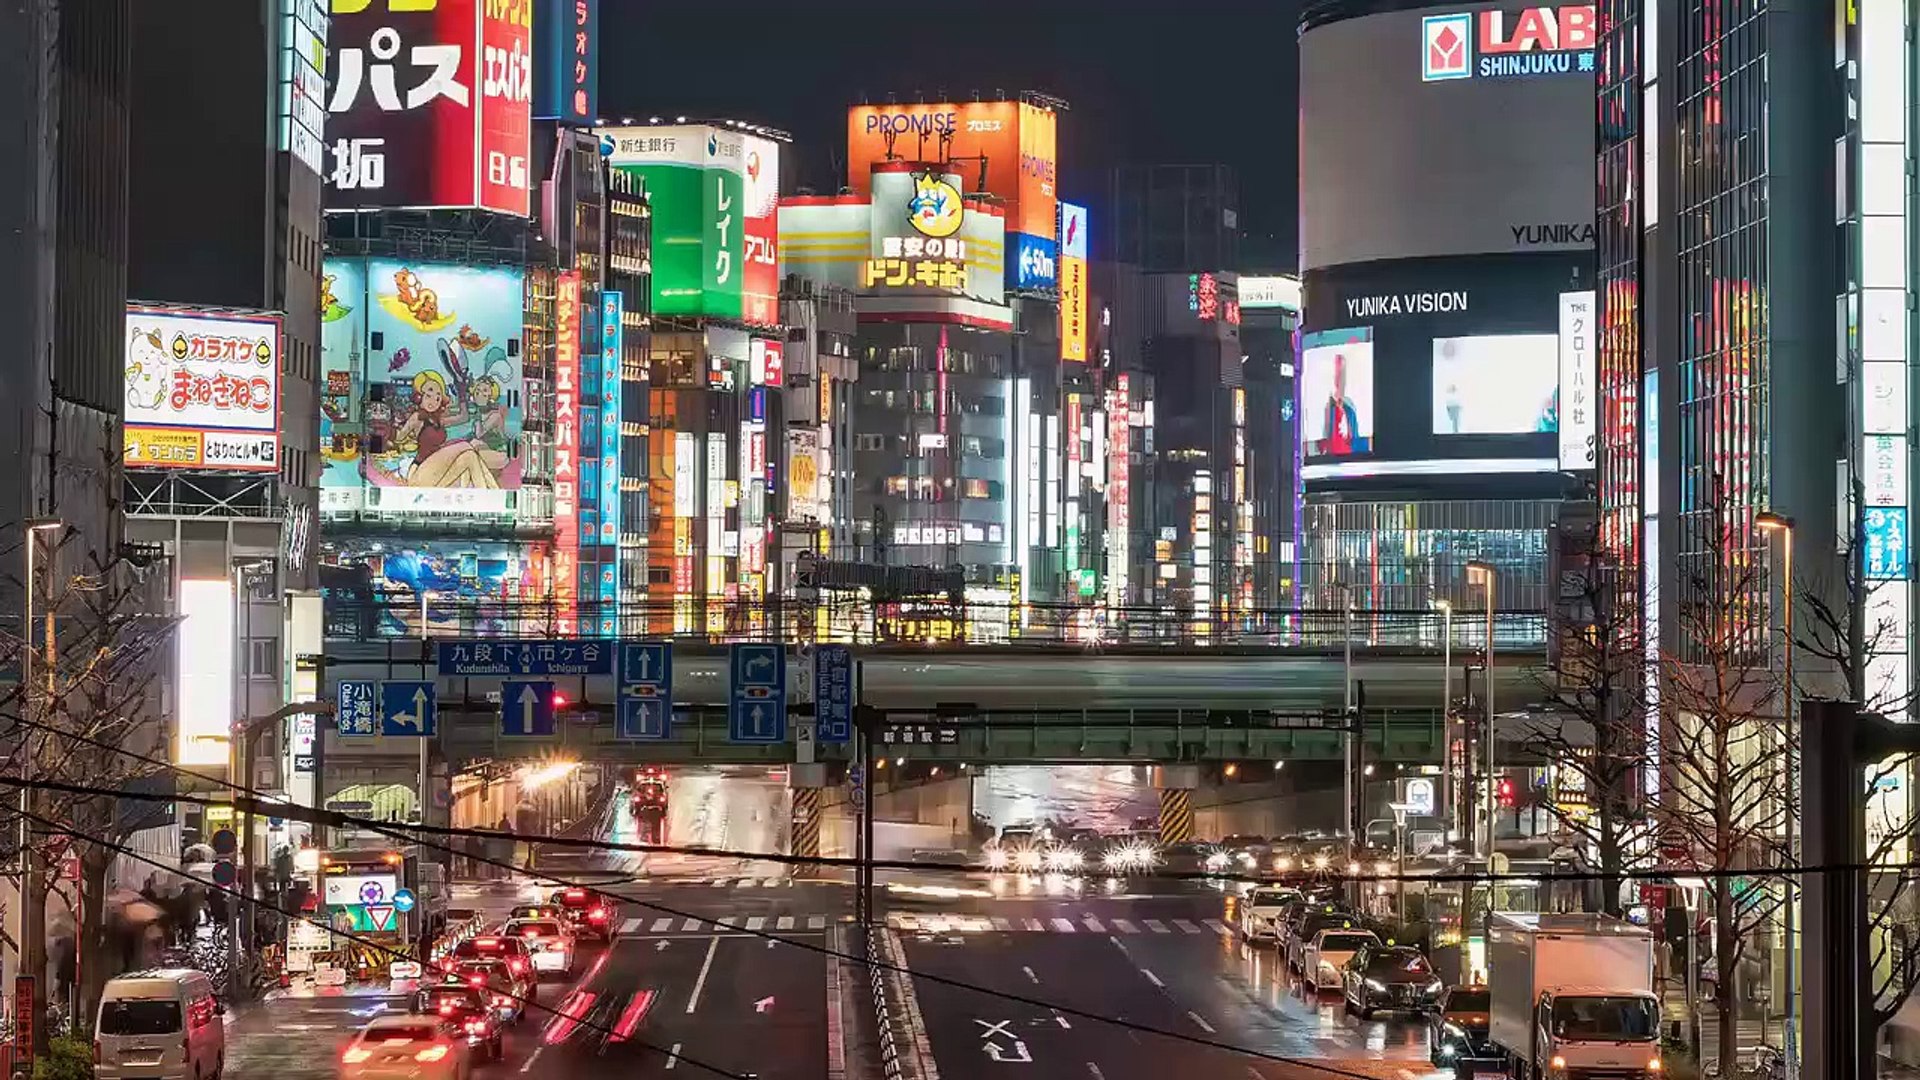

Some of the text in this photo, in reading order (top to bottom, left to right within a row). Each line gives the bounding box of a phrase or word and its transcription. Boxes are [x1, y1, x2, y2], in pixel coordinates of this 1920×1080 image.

[1480, 54, 1570, 77] SHINJUKU
[866, 113, 957, 134] PROMISE
[967, 120, 1002, 132] プロミス
[620, 138, 676, 153] 新生銀行
[715, 177, 732, 284] レイク
[1512, 224, 1596, 244] YUNIKA
[744, 234, 775, 265] アコム
[1347, 292, 1467, 318] YUNIKA VISION
[1570, 304, 1587, 313] THE
[190, 336, 253, 360] カラオケ
[170, 367, 270, 411] まねきねこ
[451, 643, 514, 662] 九段下
[455, 664, 510, 674] Kudanshita
[547, 663, 588, 675] Ichigaya
[353, 683, 372, 733] 小滝橋
